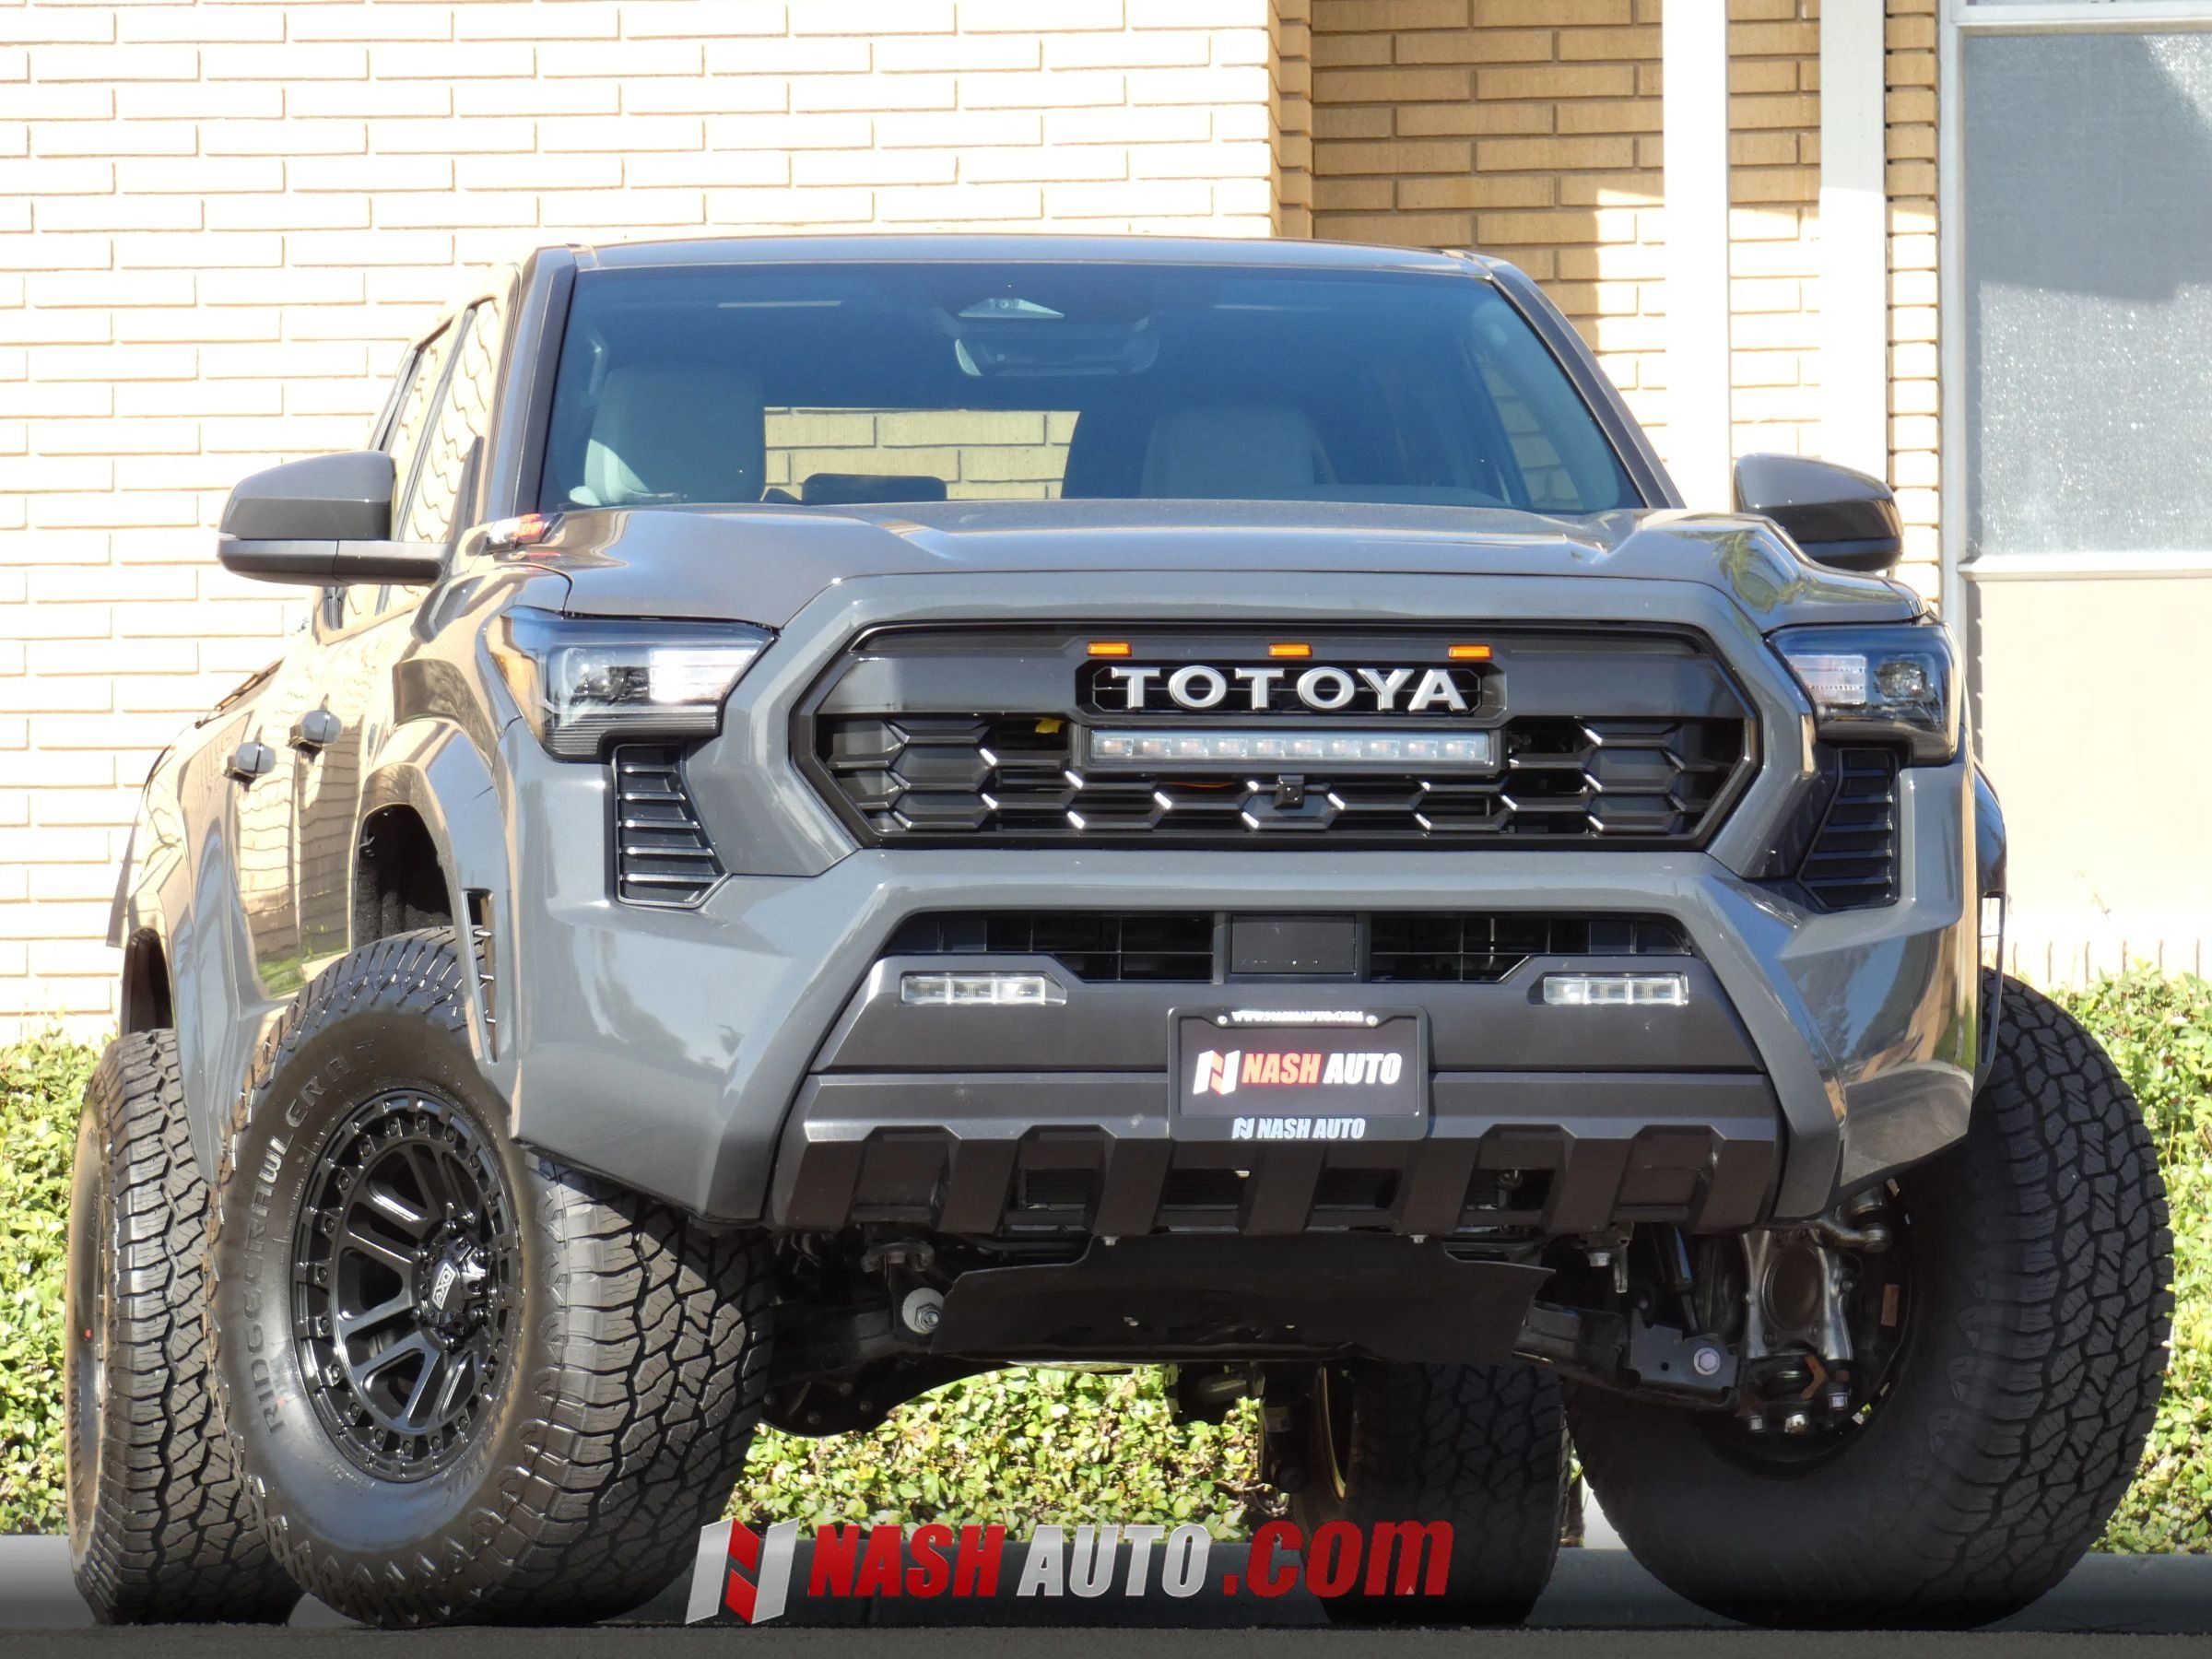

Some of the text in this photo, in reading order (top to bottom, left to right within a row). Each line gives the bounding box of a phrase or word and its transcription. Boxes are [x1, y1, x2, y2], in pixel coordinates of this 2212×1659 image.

[1112, 665, 1468, 712] TOTOYA
[1241, 1053, 1322, 1084] NASH
[1323, 1053, 1403, 1085] AUTO
[1256, 1118, 1312, 1139] NASH
[1312, 1118, 1366, 1139] AUTO
